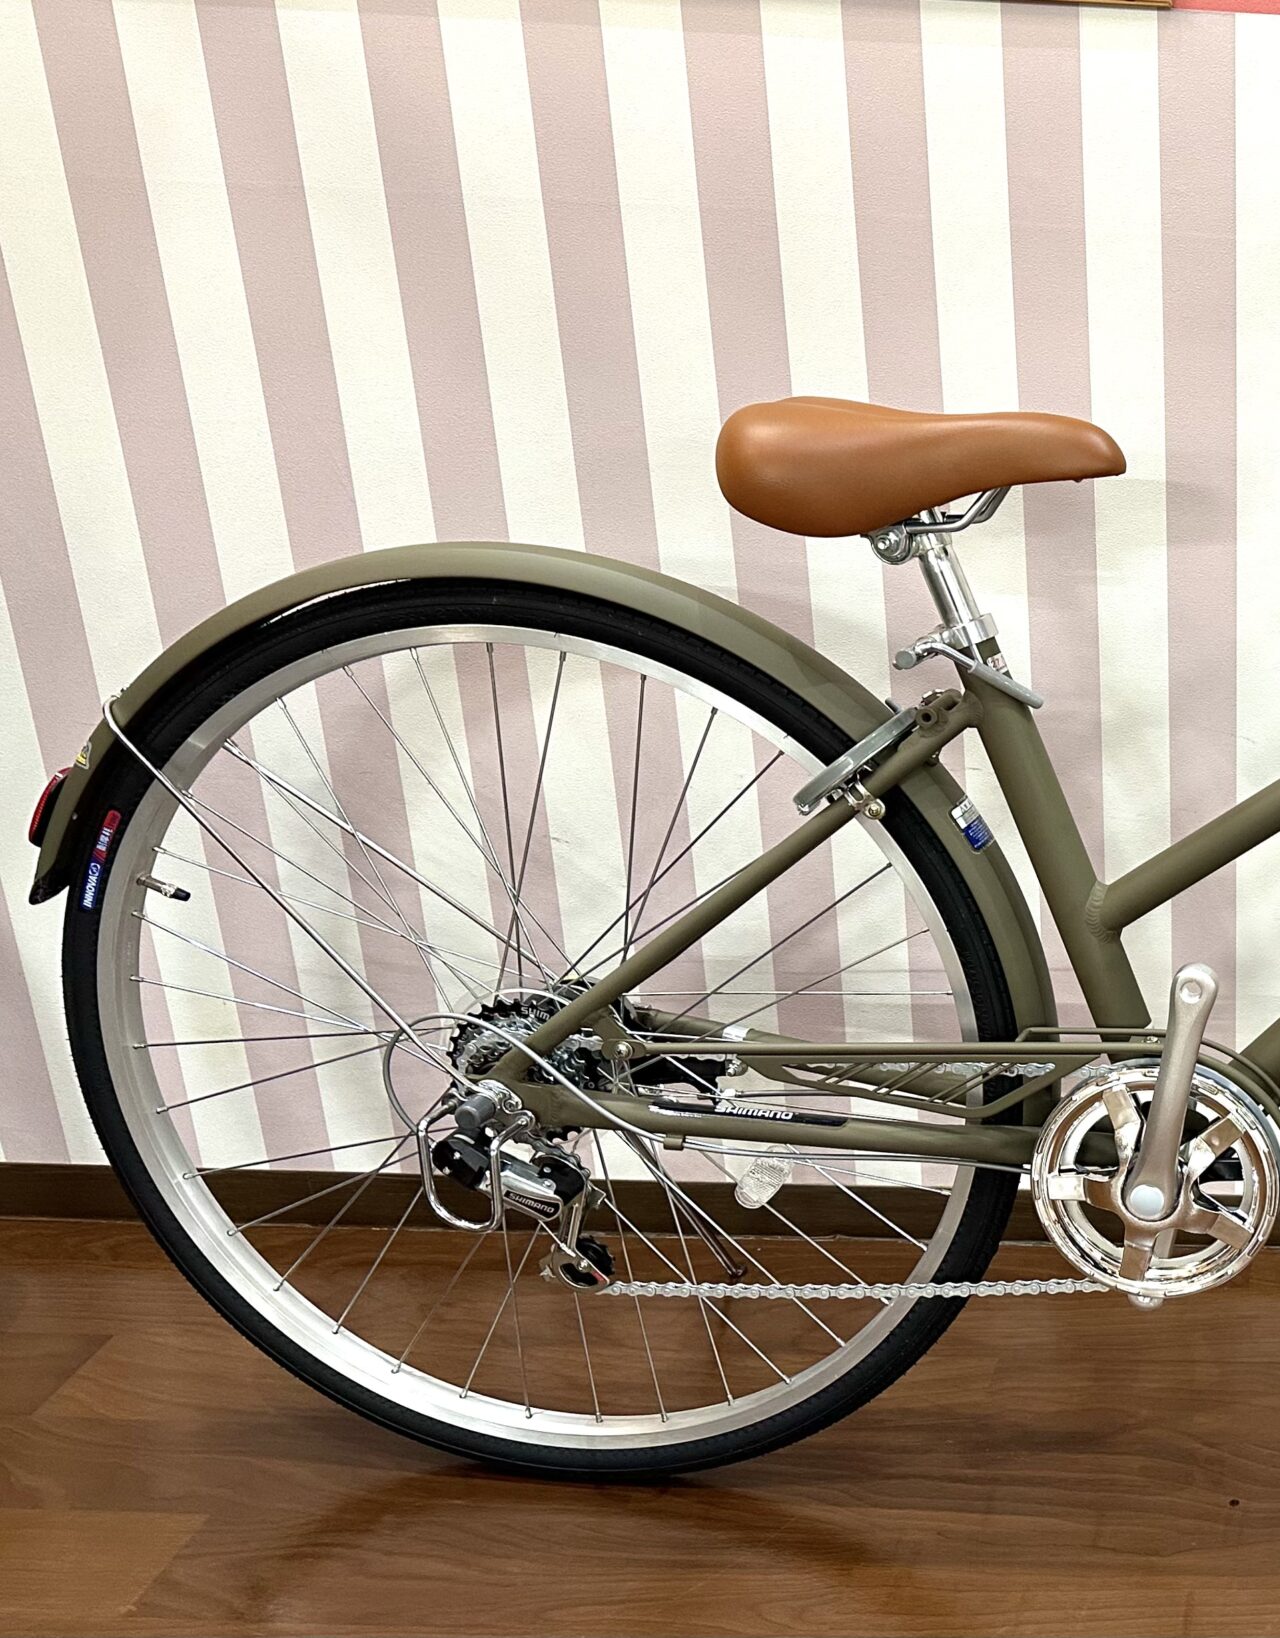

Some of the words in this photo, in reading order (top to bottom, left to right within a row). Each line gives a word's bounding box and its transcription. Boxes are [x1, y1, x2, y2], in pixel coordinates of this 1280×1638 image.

[83, 875, 99, 909] INNOVA
[714, 1105, 793, 1120] SHIMANO
[509, 1193, 555, 1213] SHIMANO
